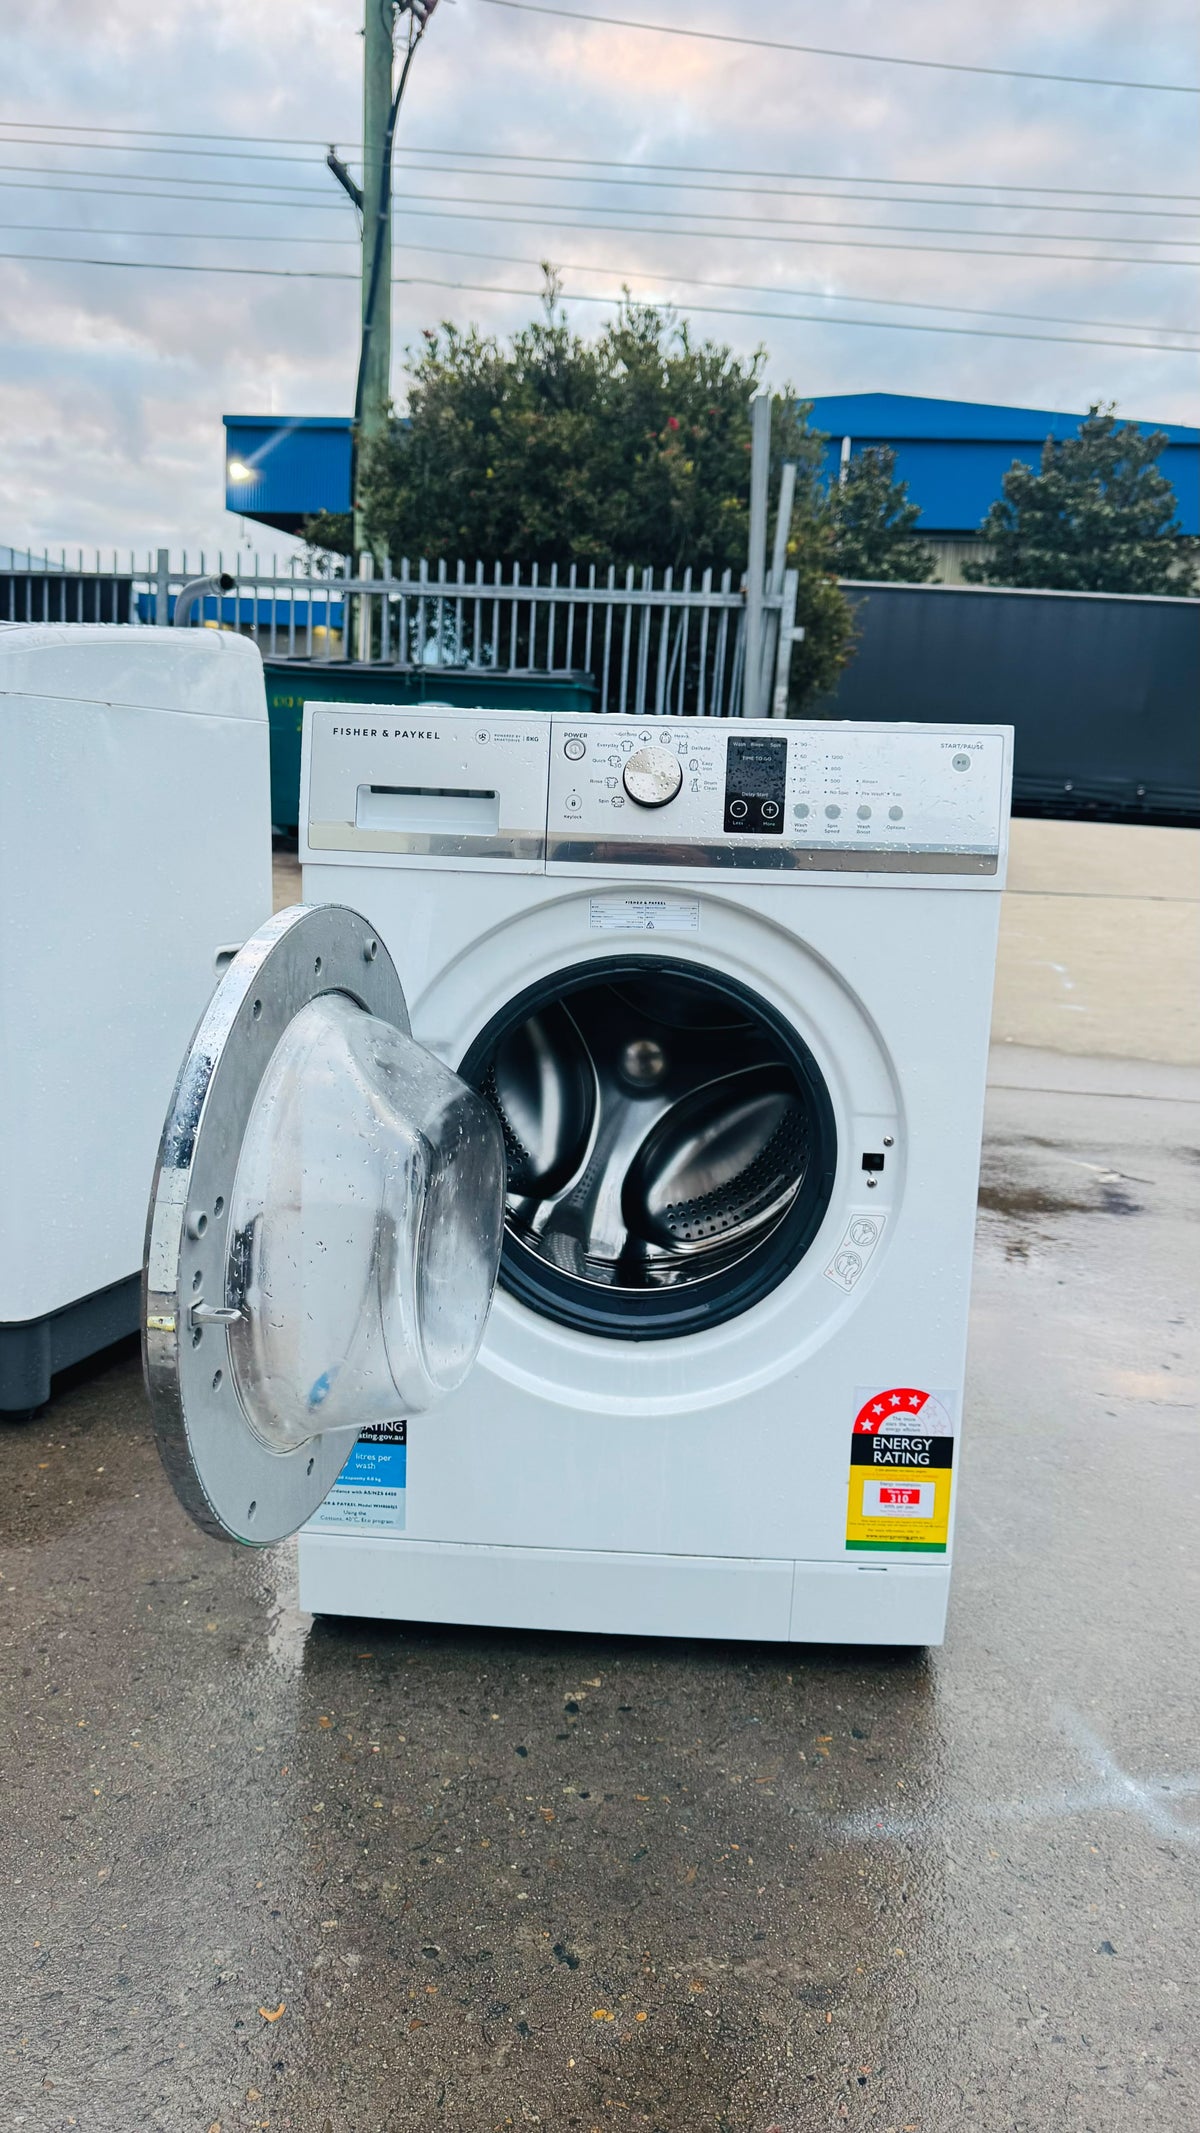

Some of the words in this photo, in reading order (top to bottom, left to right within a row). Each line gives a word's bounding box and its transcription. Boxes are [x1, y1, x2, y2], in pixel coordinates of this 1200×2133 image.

[333, 728, 377, 736] FISHER
[382, 730, 389, 738] &
[394, 730, 440, 740] PAYKEL
[362, 1422, 403, 1432] ATING
[873, 1437, 933, 1451] ENERGY
[873, 1451, 930, 1465] RATING
[890, 1494, 909, 1503] 310
